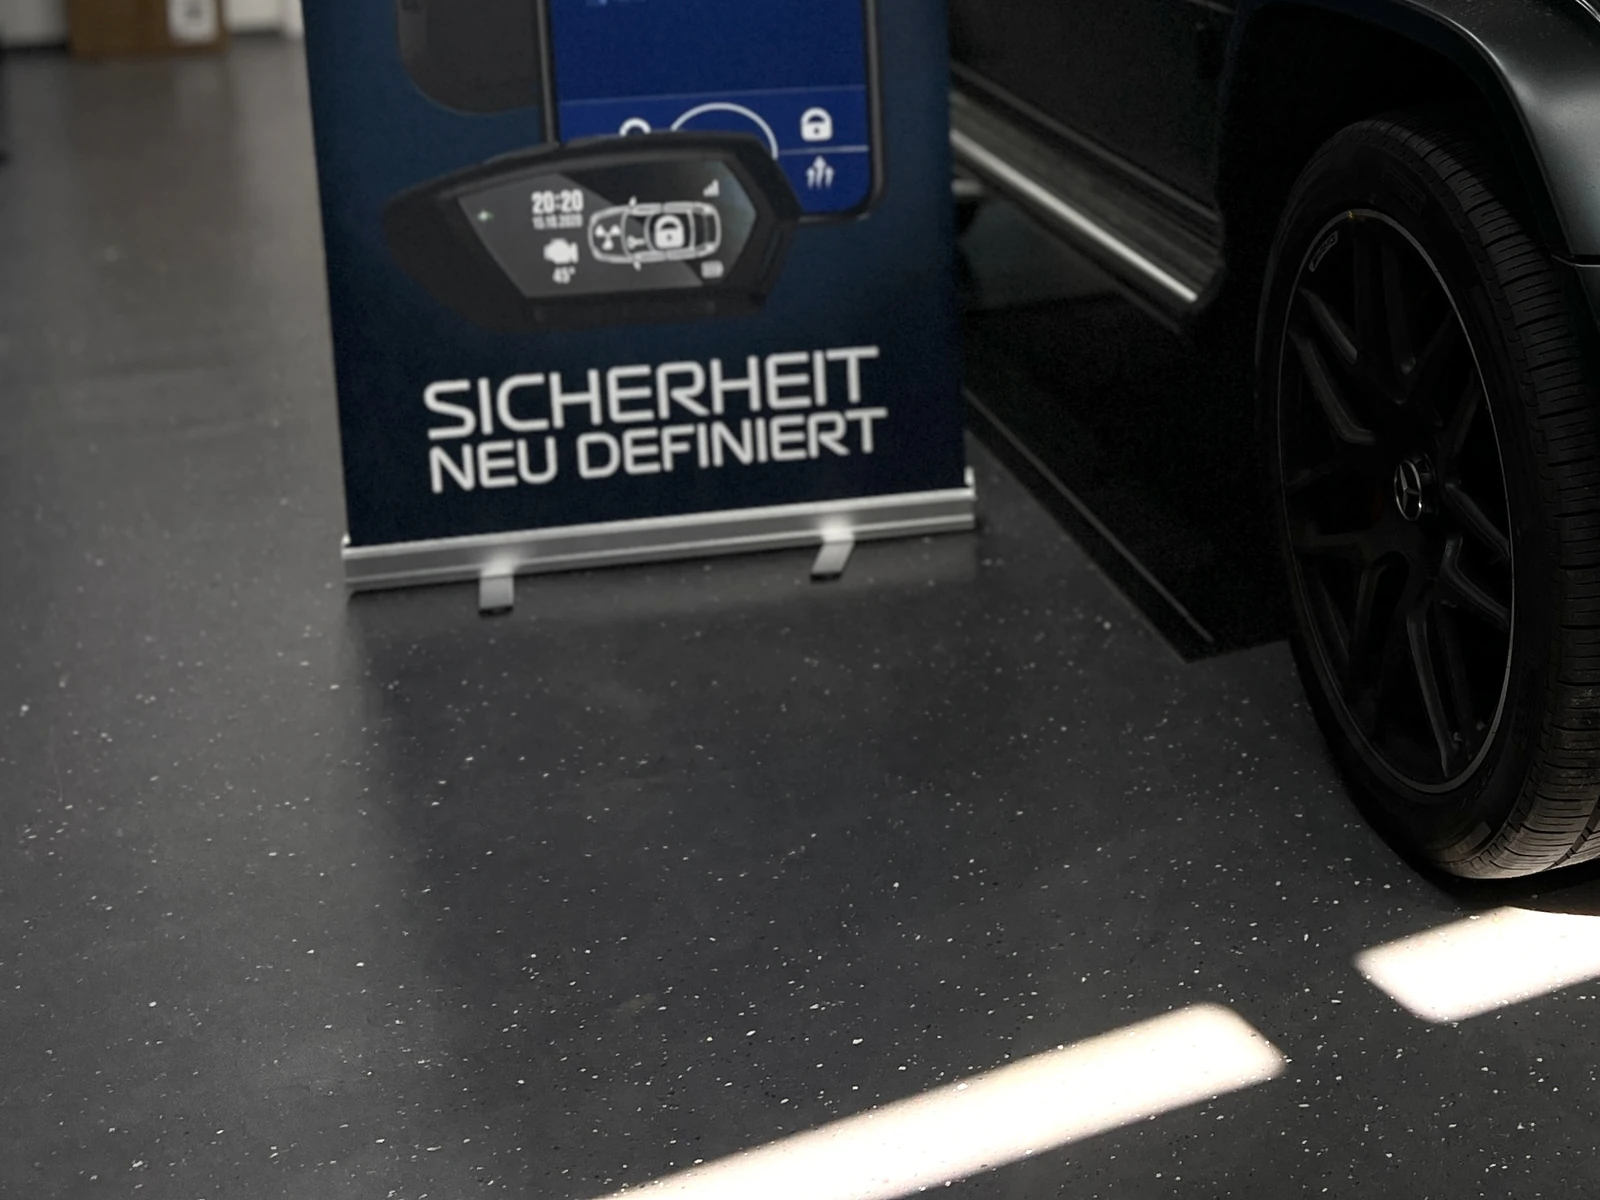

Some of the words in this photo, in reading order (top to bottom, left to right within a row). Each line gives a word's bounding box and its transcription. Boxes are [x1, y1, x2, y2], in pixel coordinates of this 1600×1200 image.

[531, 189, 584, 214] 20:20
[423, 346, 879, 440] SICHERHEIT
[429, 436, 557, 493] NEU
[576, 407, 888, 479] DEFINIERT
